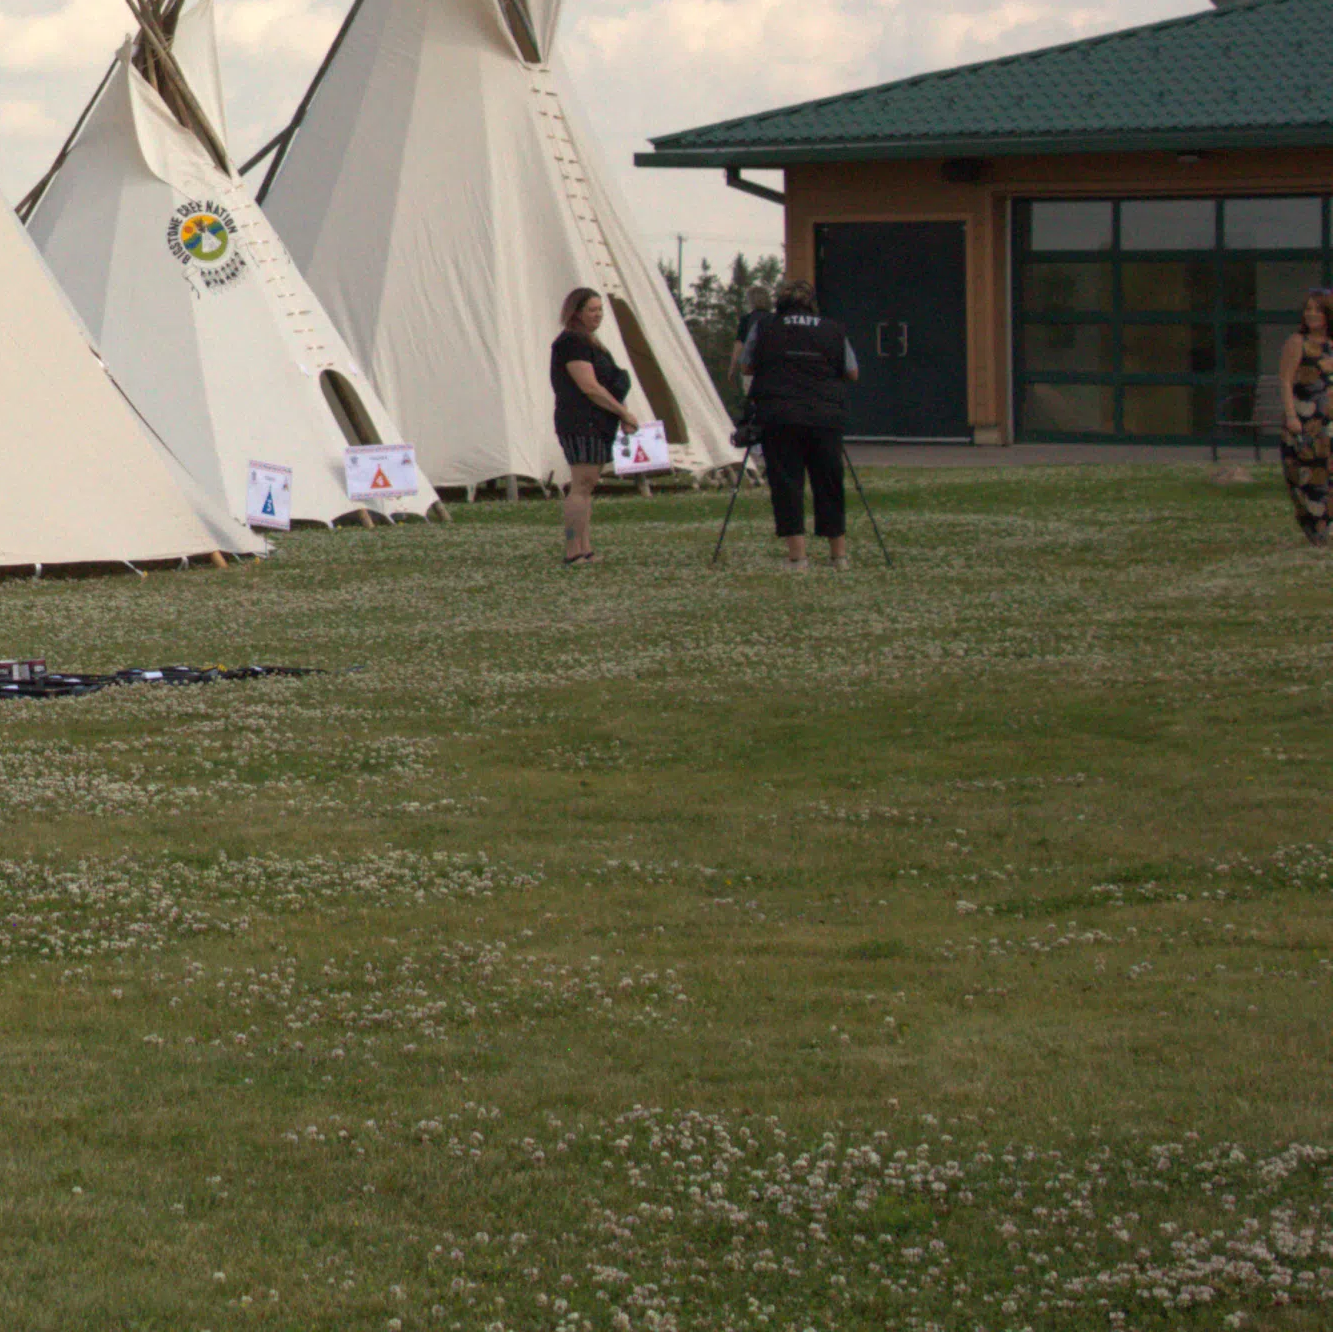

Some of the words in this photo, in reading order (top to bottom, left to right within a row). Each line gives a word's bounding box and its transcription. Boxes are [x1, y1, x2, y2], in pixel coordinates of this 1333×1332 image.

[177, 200, 202, 217] CREE
[205, 200, 238, 234] NATION
[783, 314, 821, 327] STAFF
